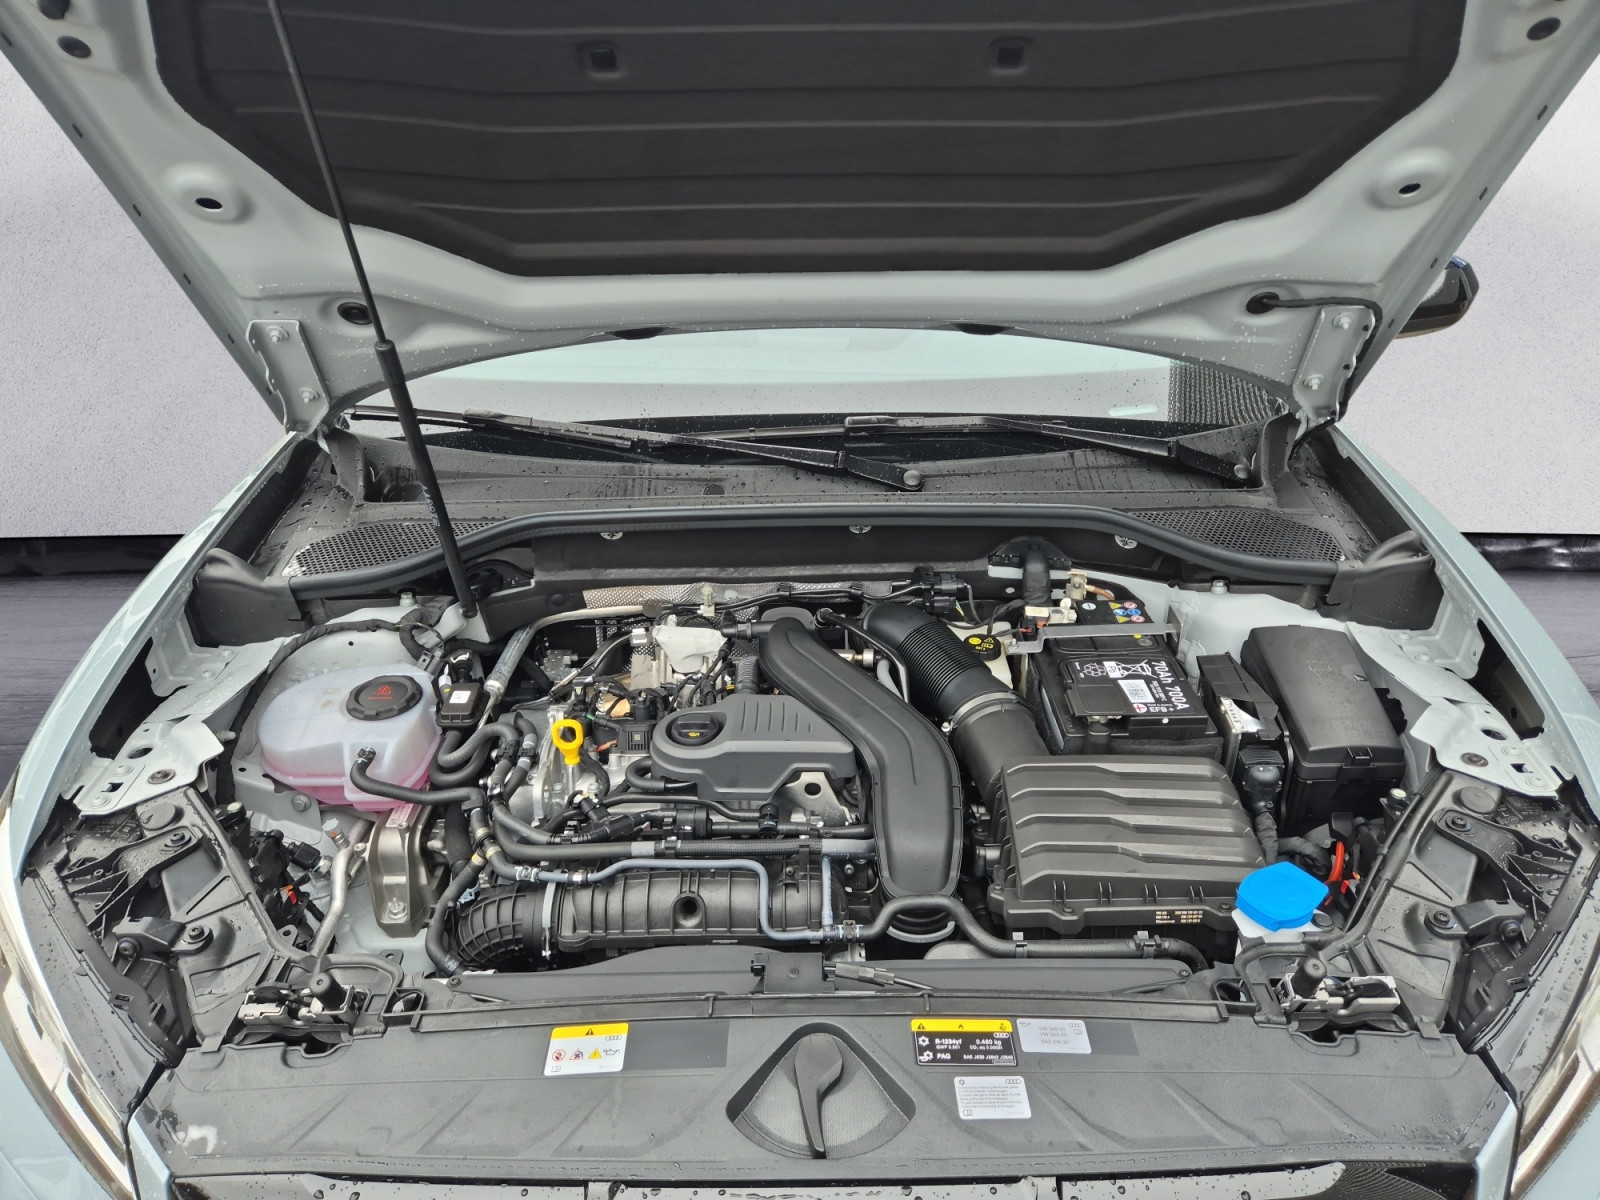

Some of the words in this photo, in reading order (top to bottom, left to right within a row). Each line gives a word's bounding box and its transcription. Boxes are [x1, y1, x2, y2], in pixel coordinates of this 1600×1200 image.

[1151, 660, 1175, 684] 70Ah
[1165, 685, 1190, 710] 700A
[993, 1038, 1002, 1046] kg
[936, 1052, 951, 1060] PAG
